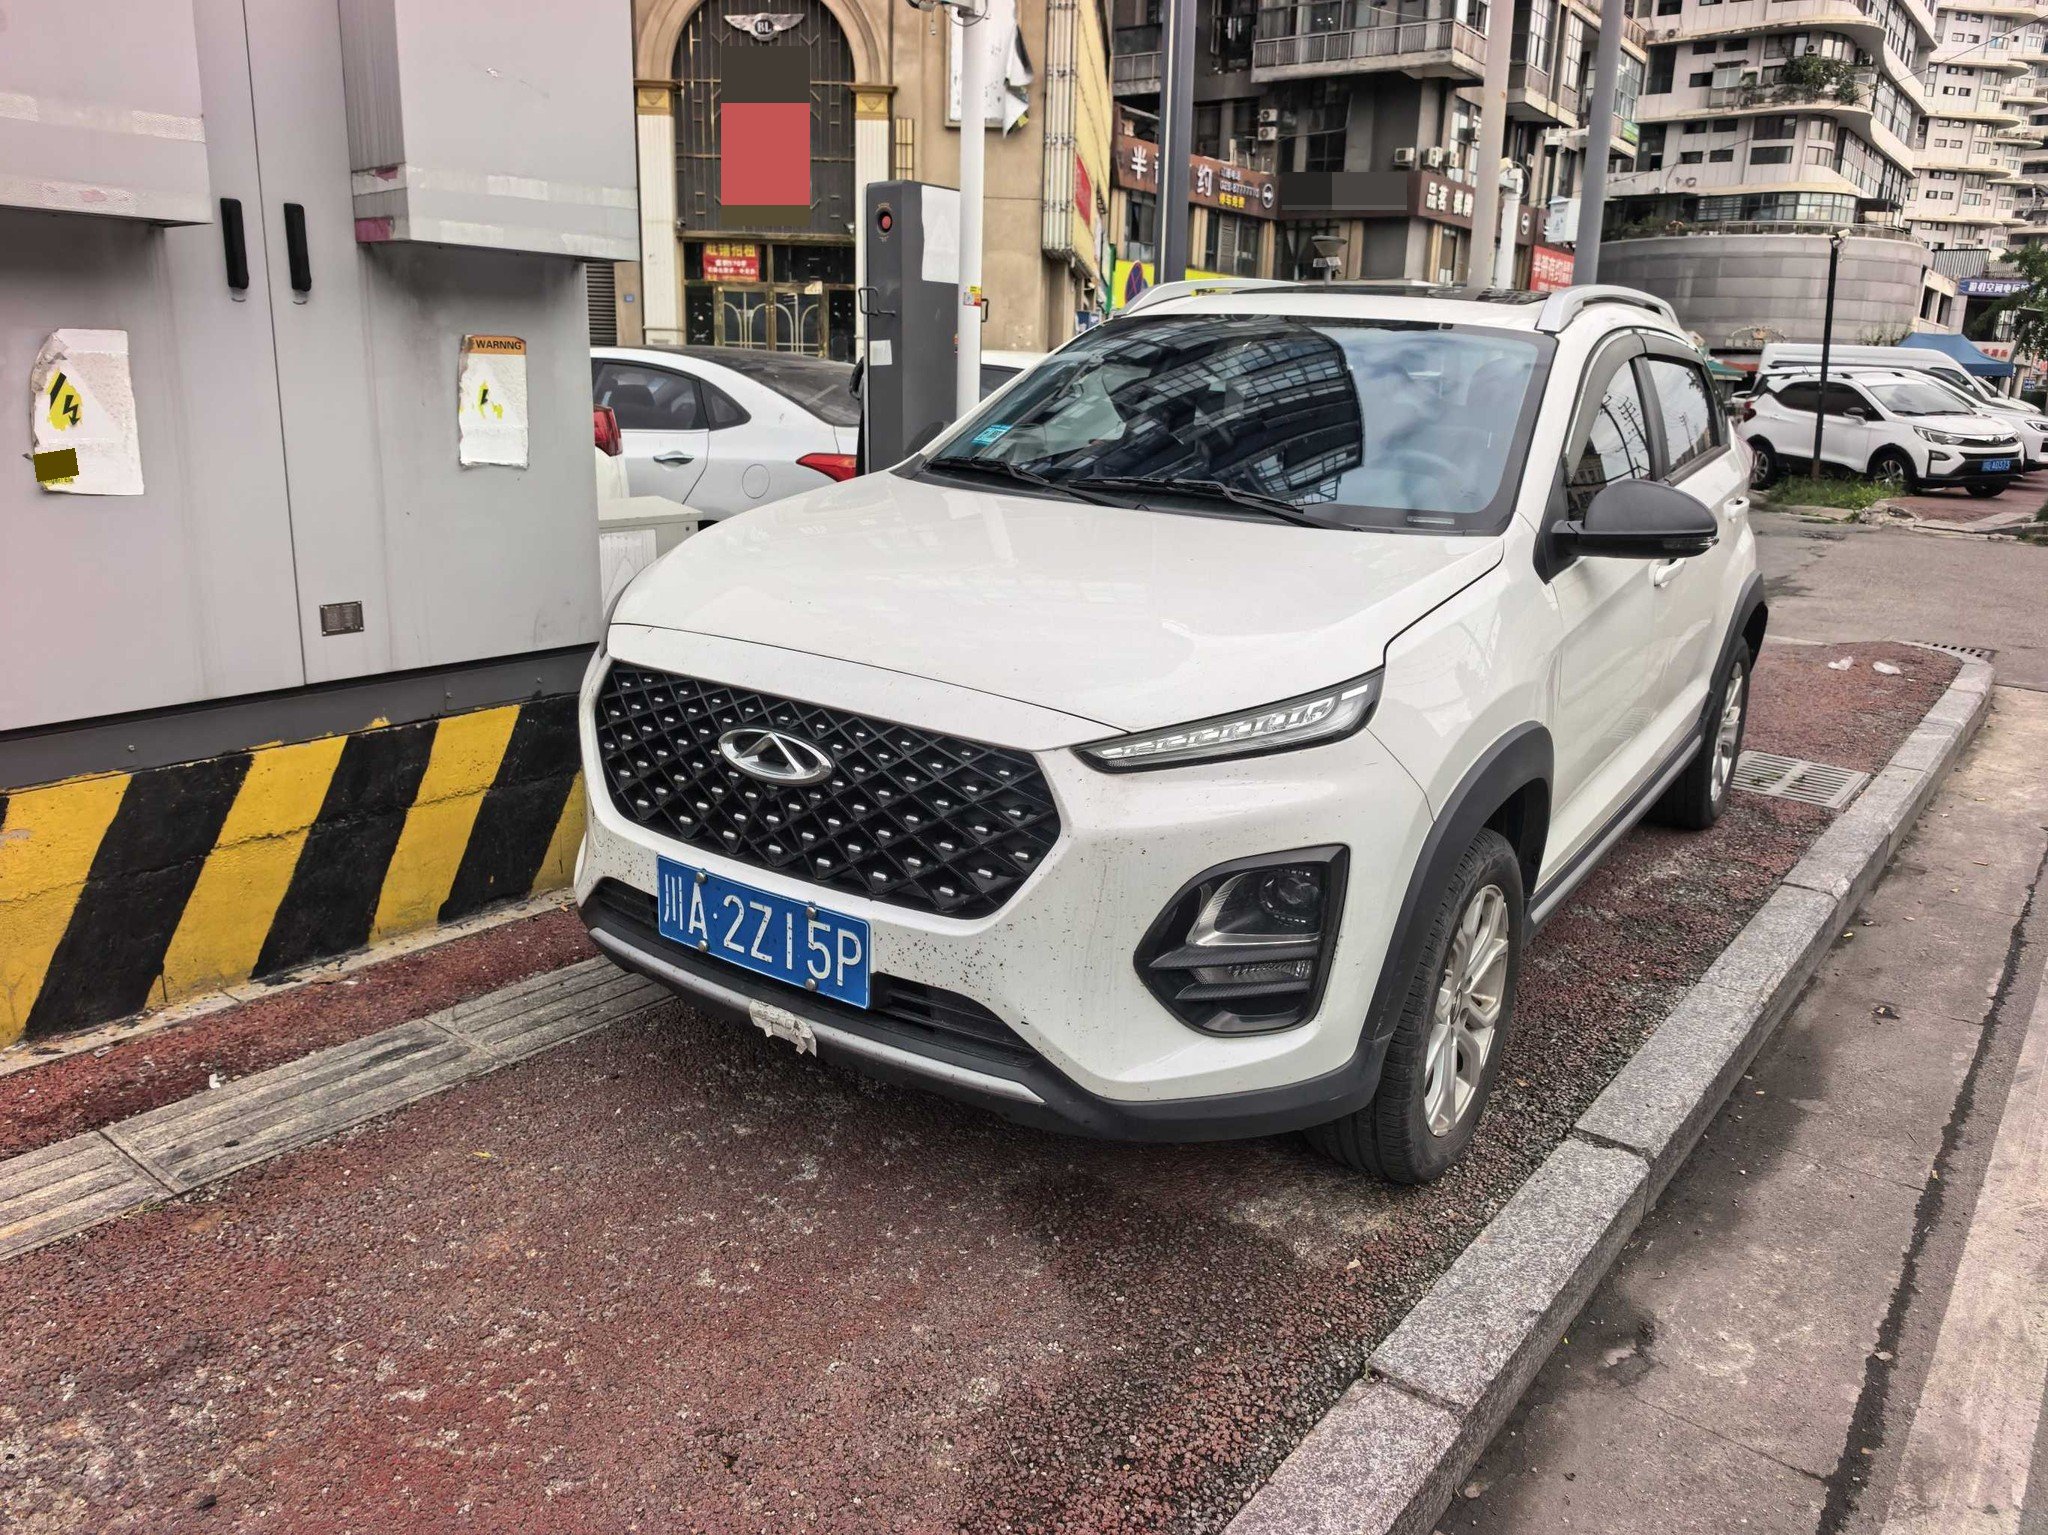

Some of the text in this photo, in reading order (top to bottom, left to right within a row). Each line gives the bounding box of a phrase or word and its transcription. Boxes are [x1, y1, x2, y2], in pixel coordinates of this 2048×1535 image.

[756, 20, 771, 33] BL
[1425, 181, 1449, 211] 品茗
[475, 339, 522, 350] WARNNG
